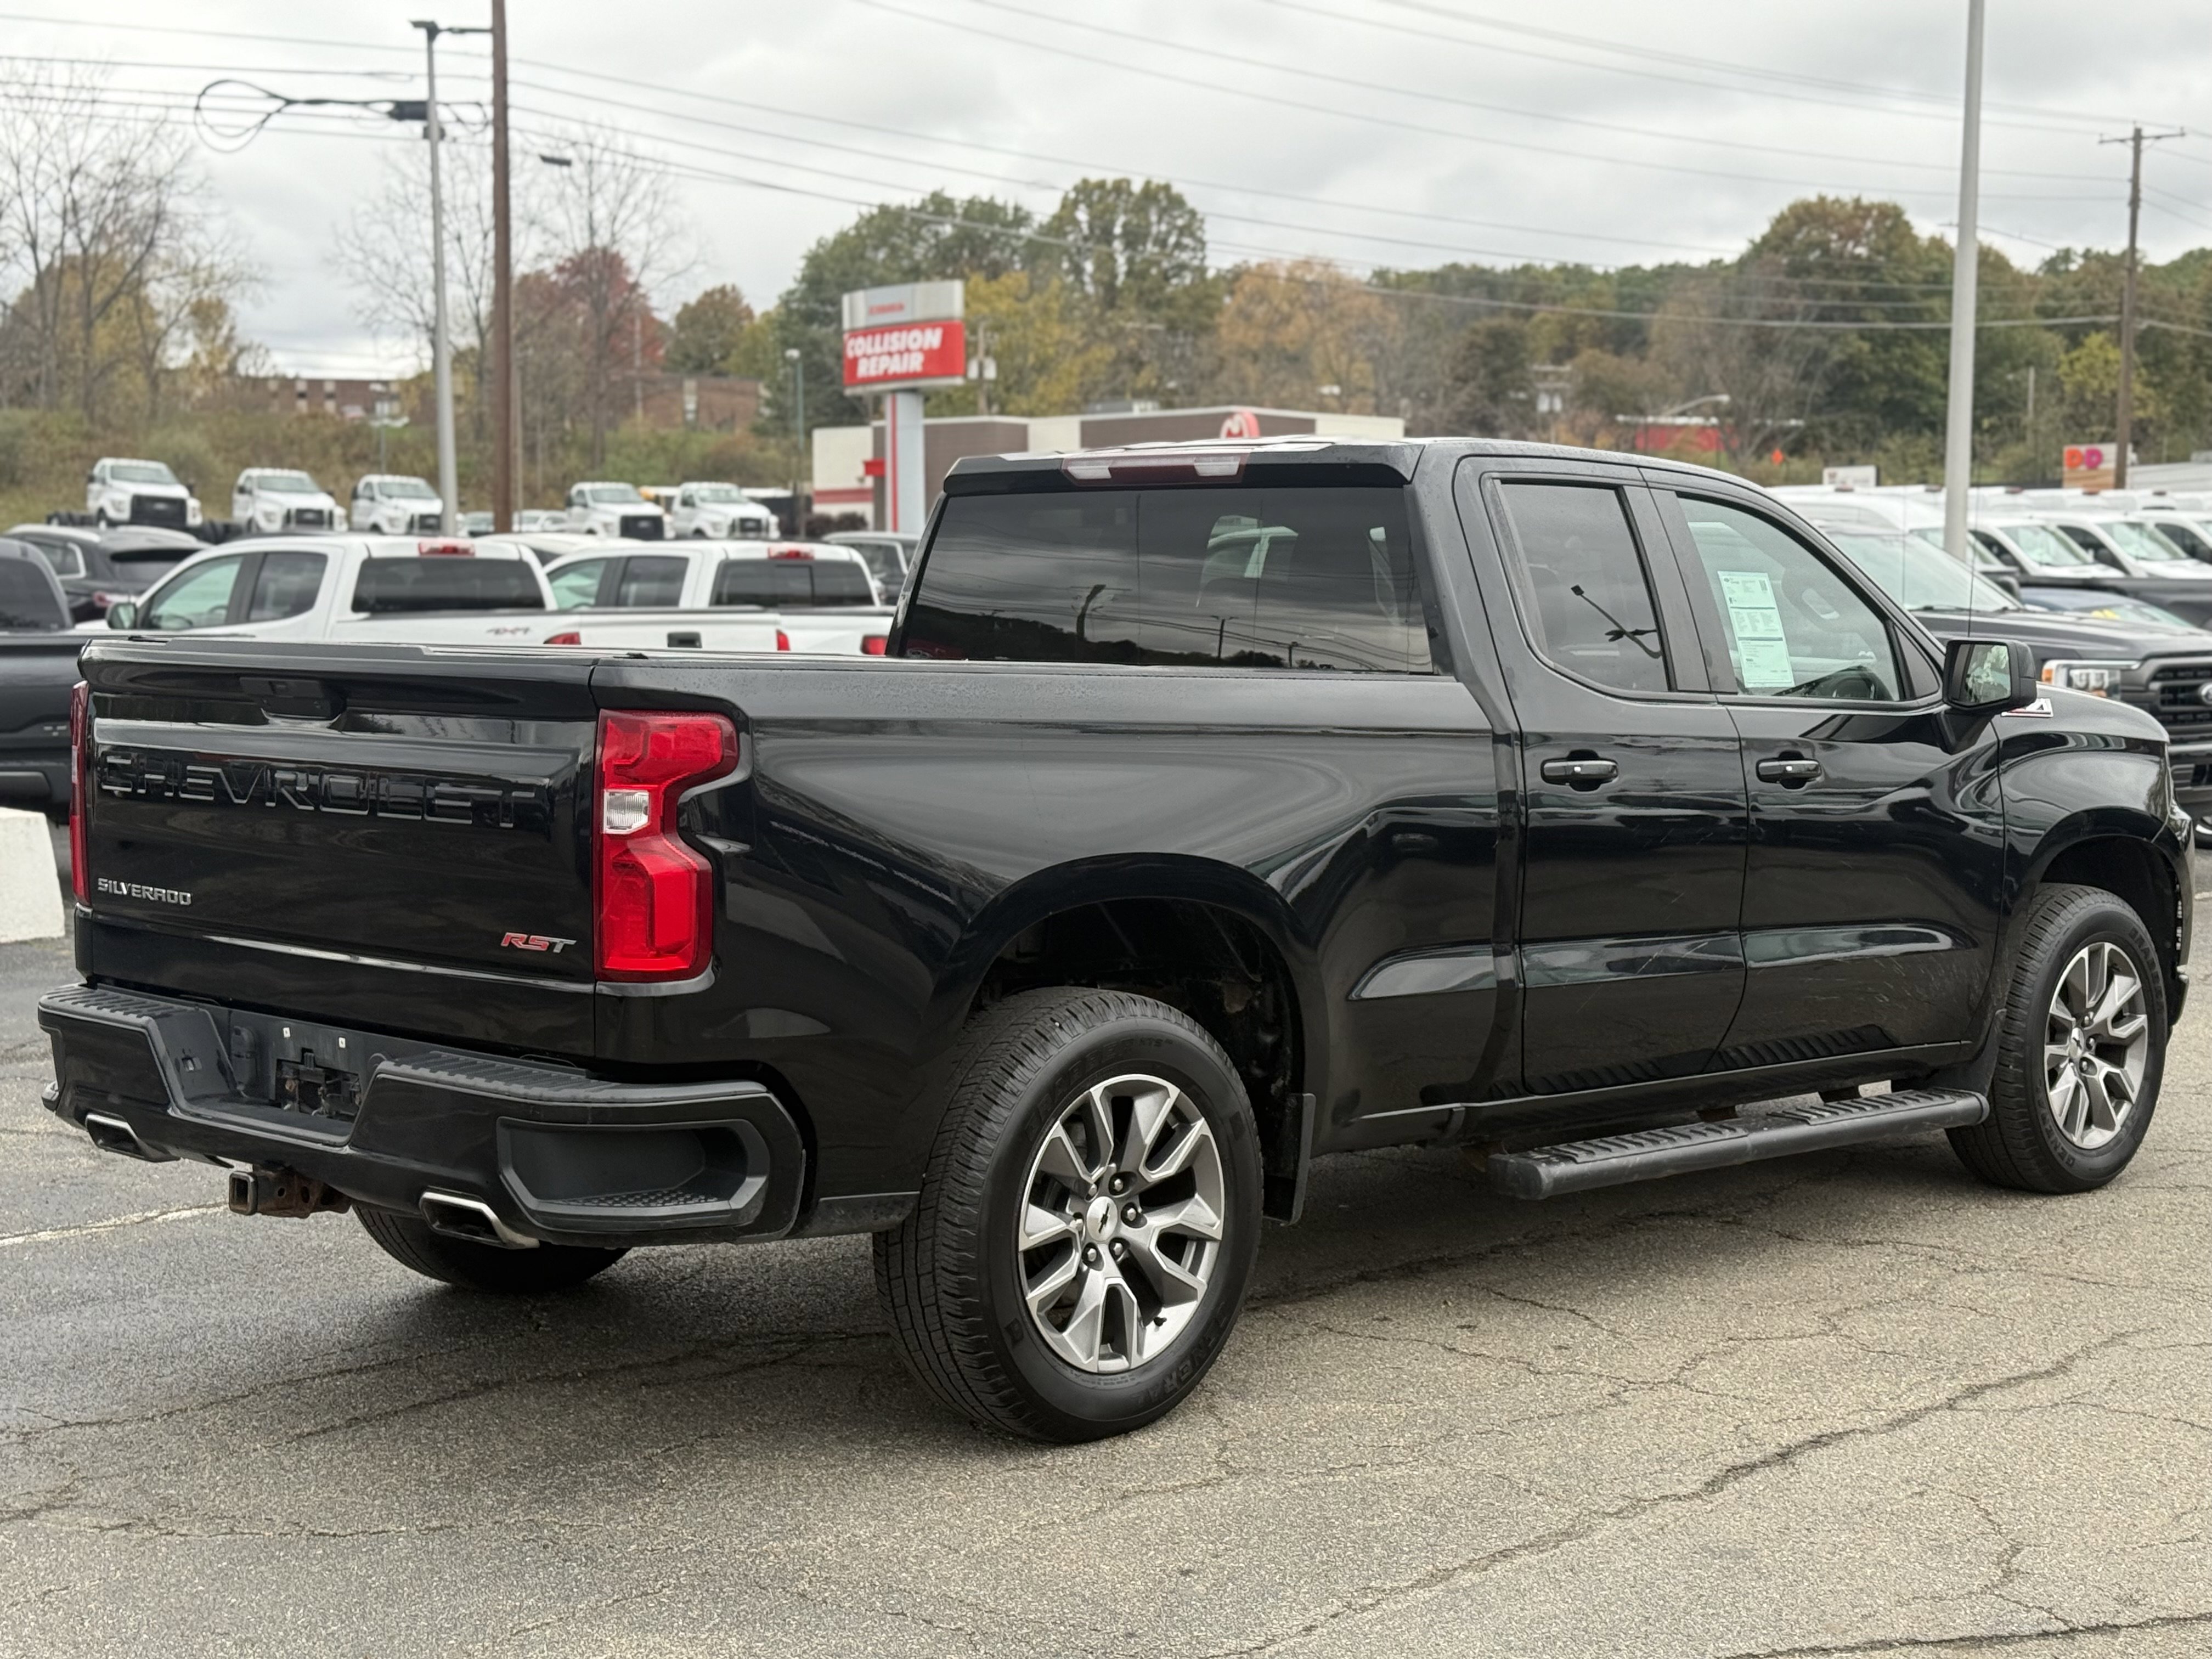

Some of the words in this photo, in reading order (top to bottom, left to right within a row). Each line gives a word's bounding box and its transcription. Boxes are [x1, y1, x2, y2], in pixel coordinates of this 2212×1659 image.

[847, 328, 943, 359] COLLISION
[857, 352, 924, 377] REPAIR
[100, 752, 539, 829] CHEVROLET
[97, 878, 193, 907] SILVERADO
[500, 932, 577, 954] RST
